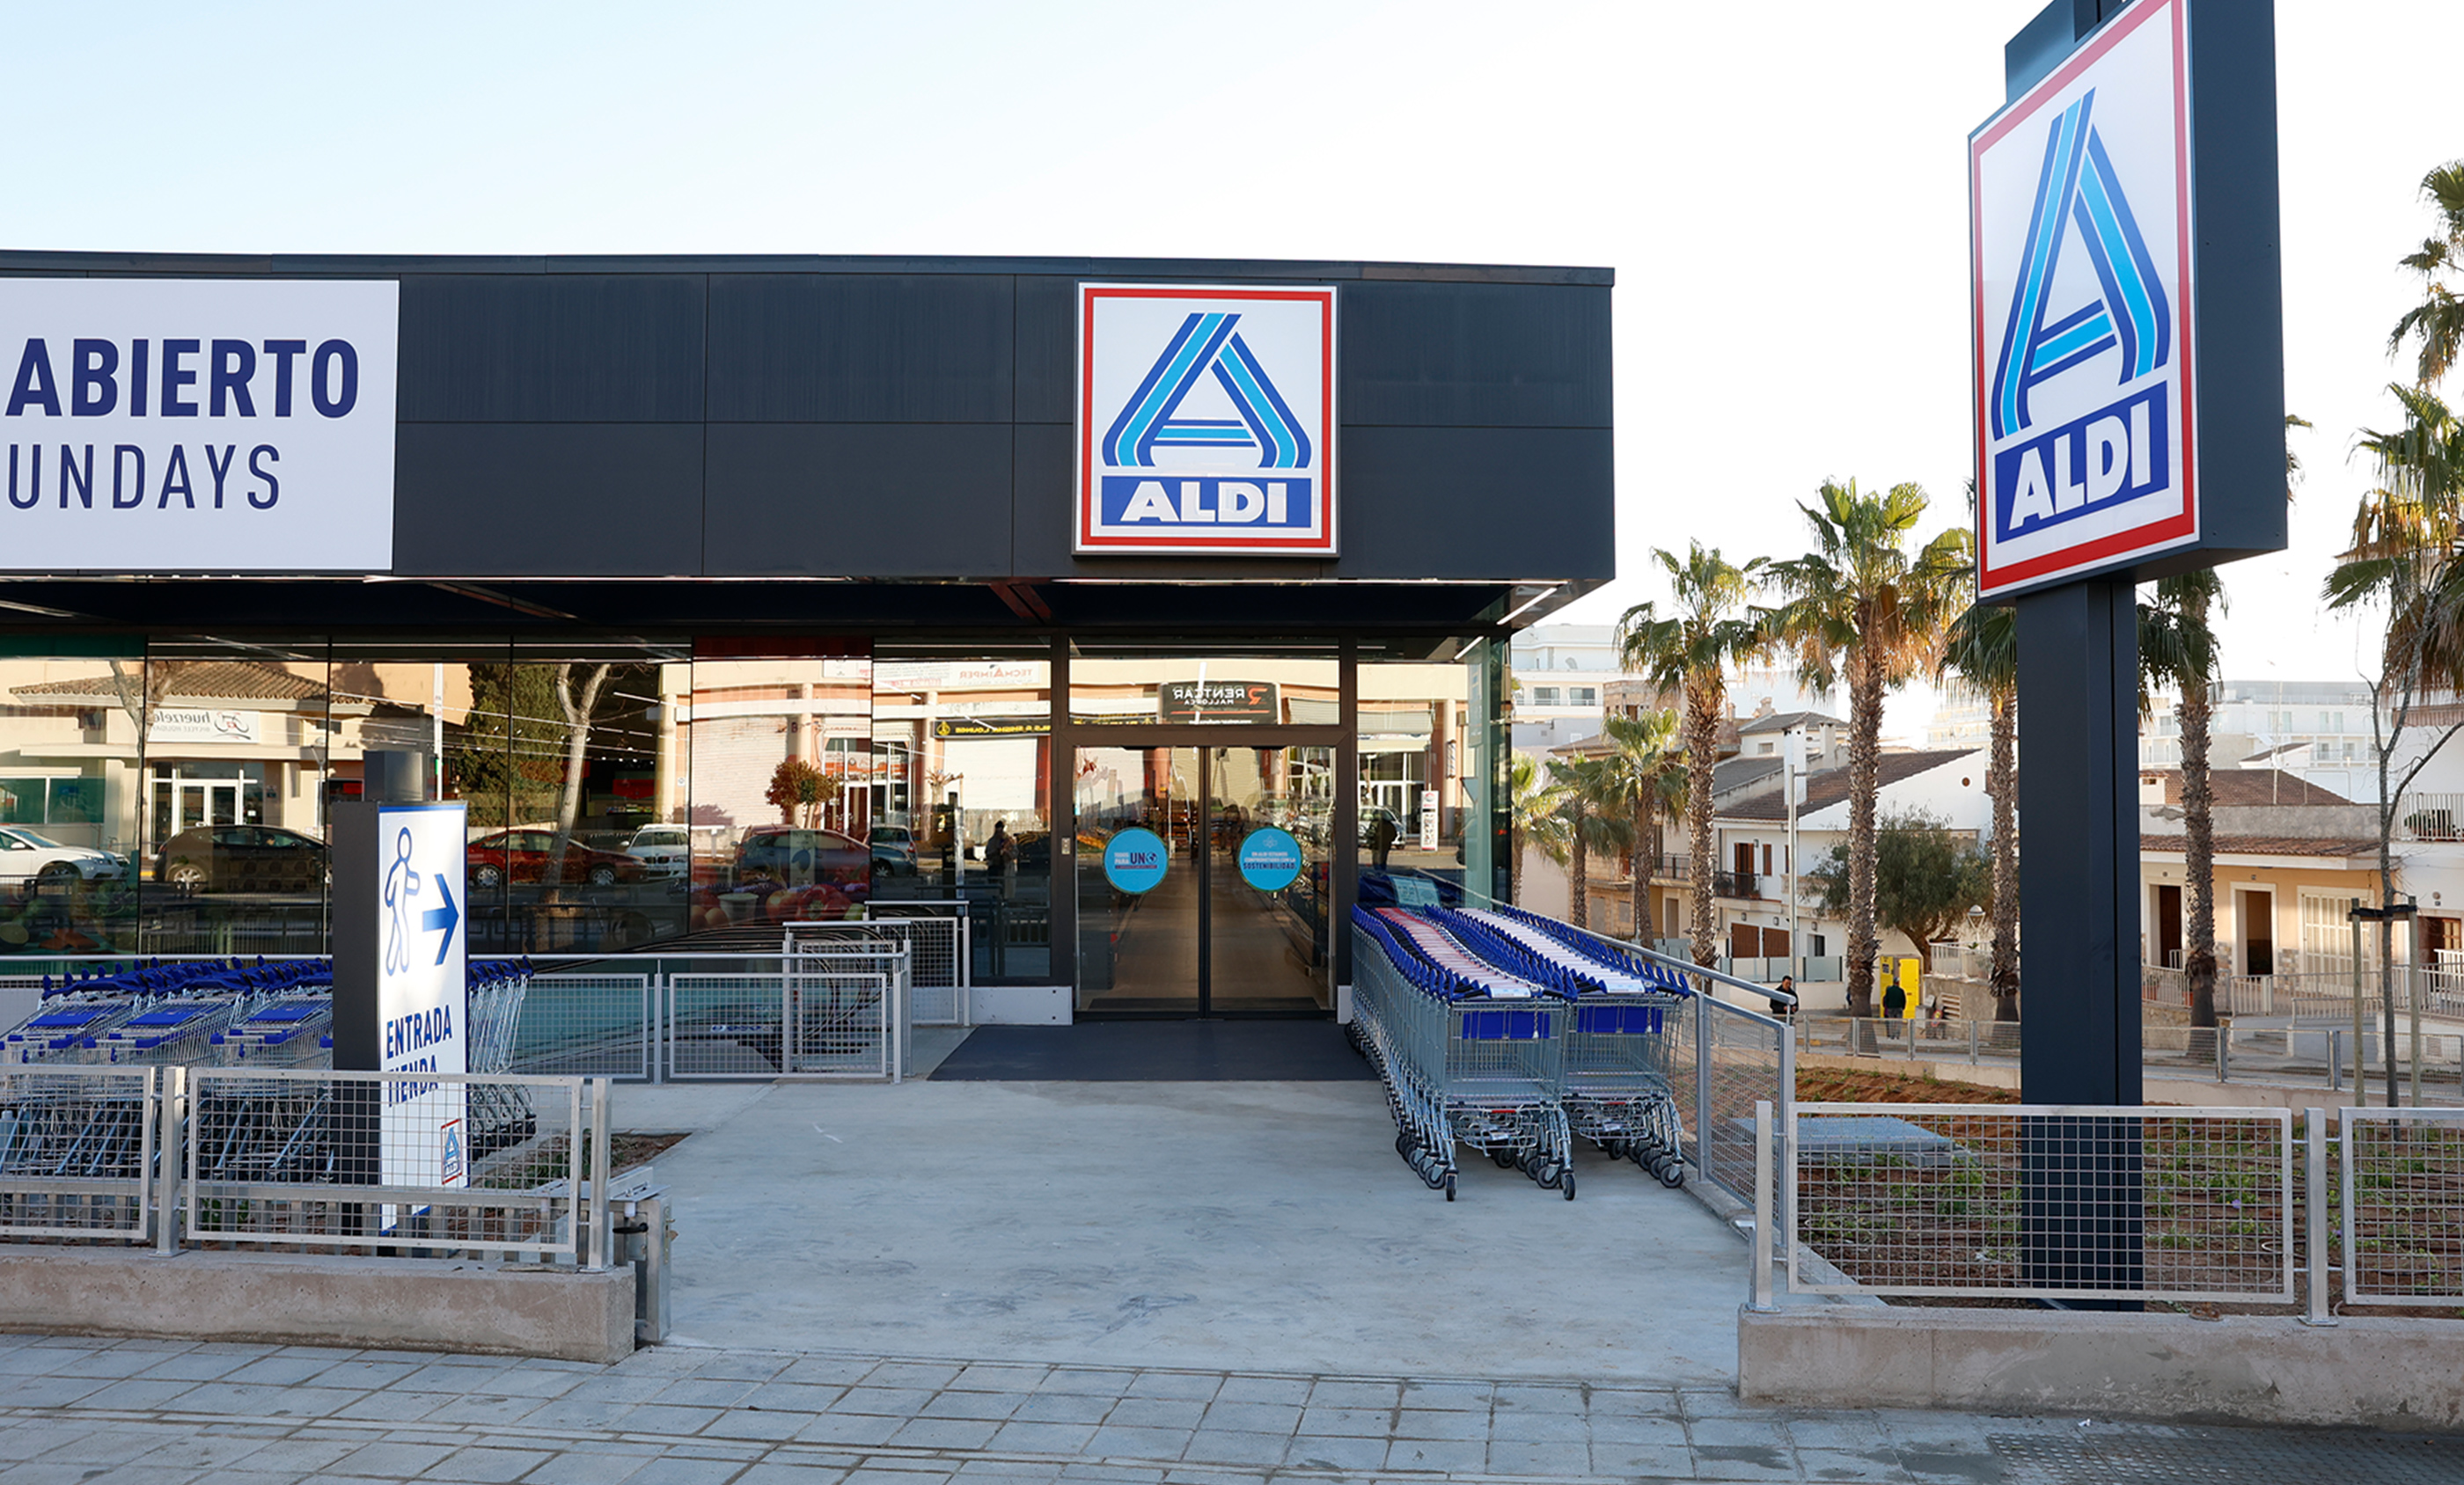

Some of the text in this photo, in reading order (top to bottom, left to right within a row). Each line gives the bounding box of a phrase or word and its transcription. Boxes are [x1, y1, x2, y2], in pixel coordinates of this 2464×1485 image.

[4, 338, 359, 418] ABIERTO
[7, 443, 281, 509] UNDAYS
[2008, 399, 2151, 530] ALDI
[1120, 480, 1287, 523] ALDI
[386, 1005, 452, 1059] ENTRADA
[388, 1055, 438, 1108] TIENDA
